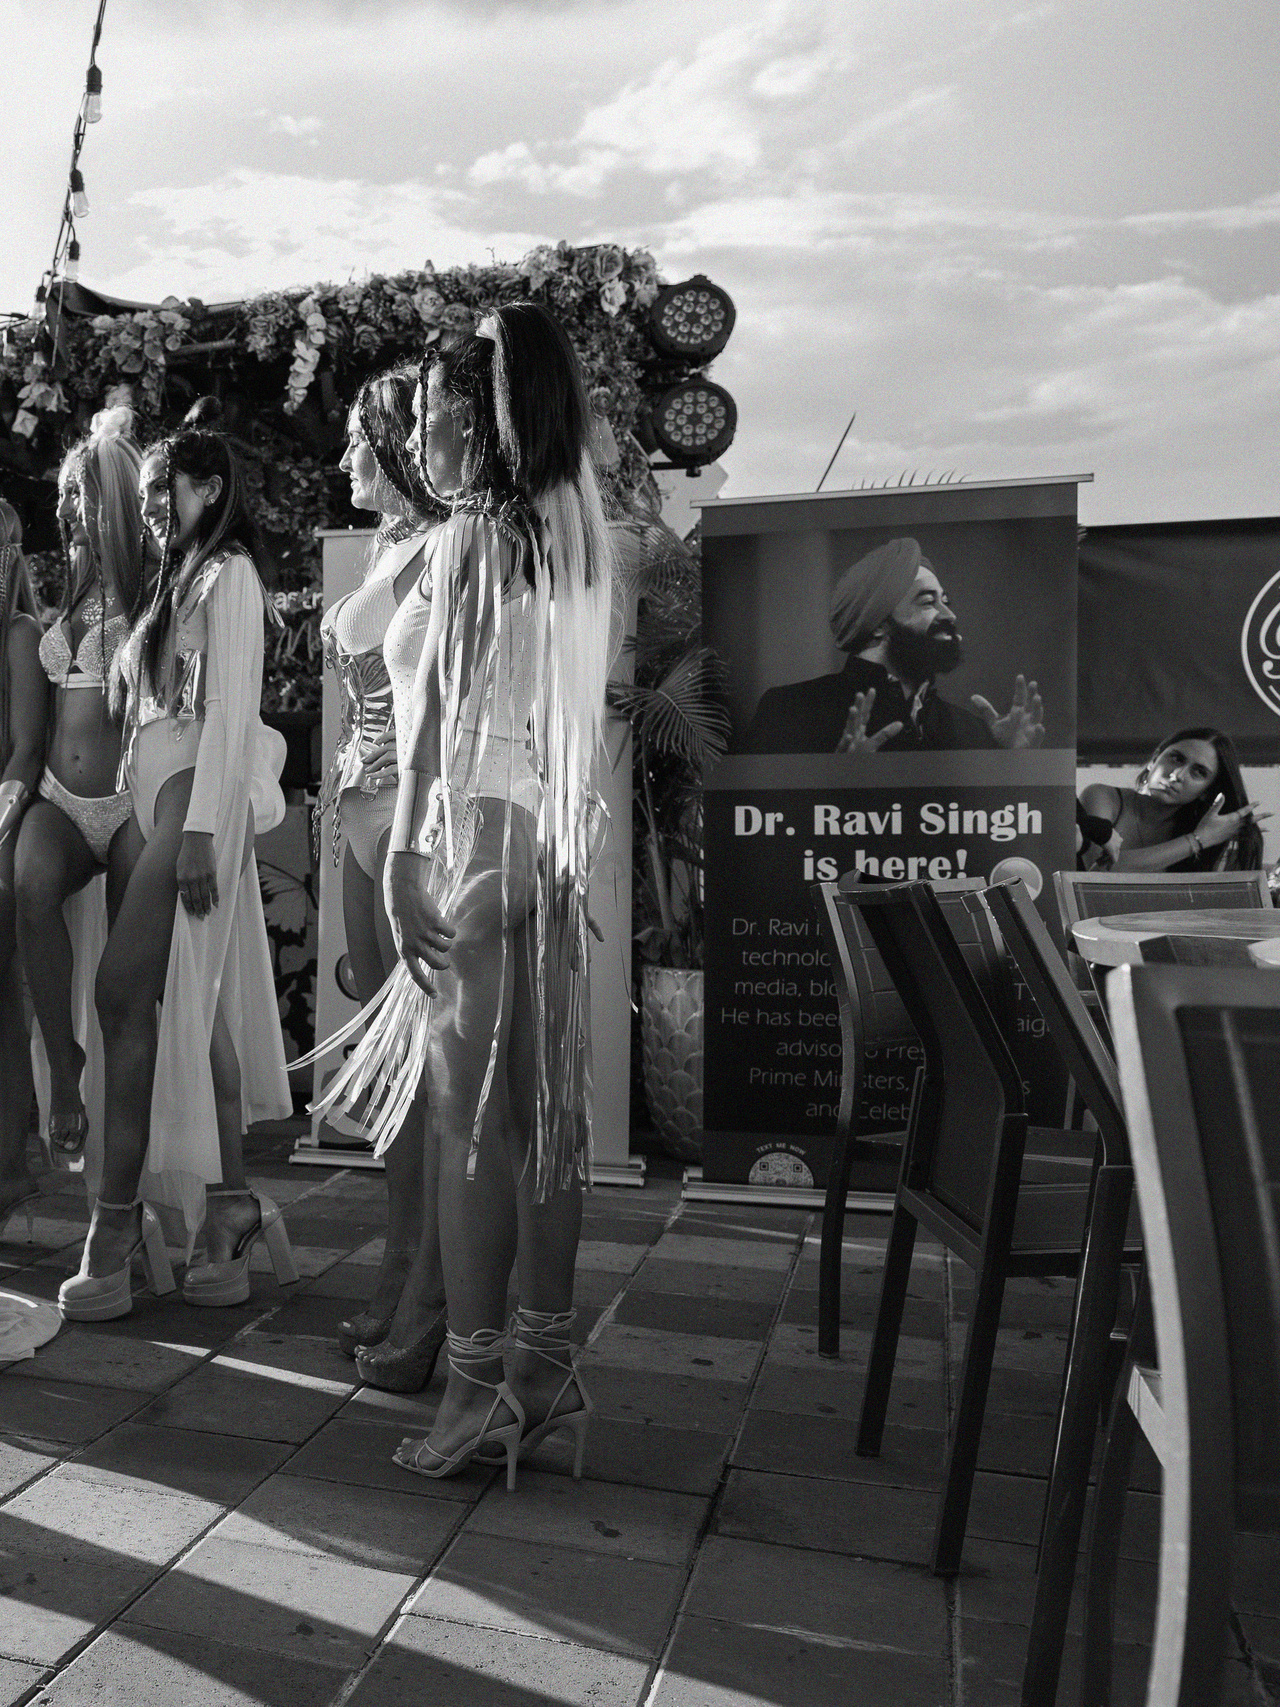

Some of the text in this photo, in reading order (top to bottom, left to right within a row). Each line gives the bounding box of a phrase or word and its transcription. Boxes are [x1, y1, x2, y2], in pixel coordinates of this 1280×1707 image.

[734, 802, 1043, 842] Dr. Ravi Singh
[803, 849, 968, 881] is here!
[732, 918, 761, 936] Dr.
[769, 918, 809, 936] Ravi
[734, 979, 802, 998] media,
[721, 1007, 841, 1028] He has bee
[776, 1039, 843, 1058] adviso
[749, 1067, 806, 1087] Prime
